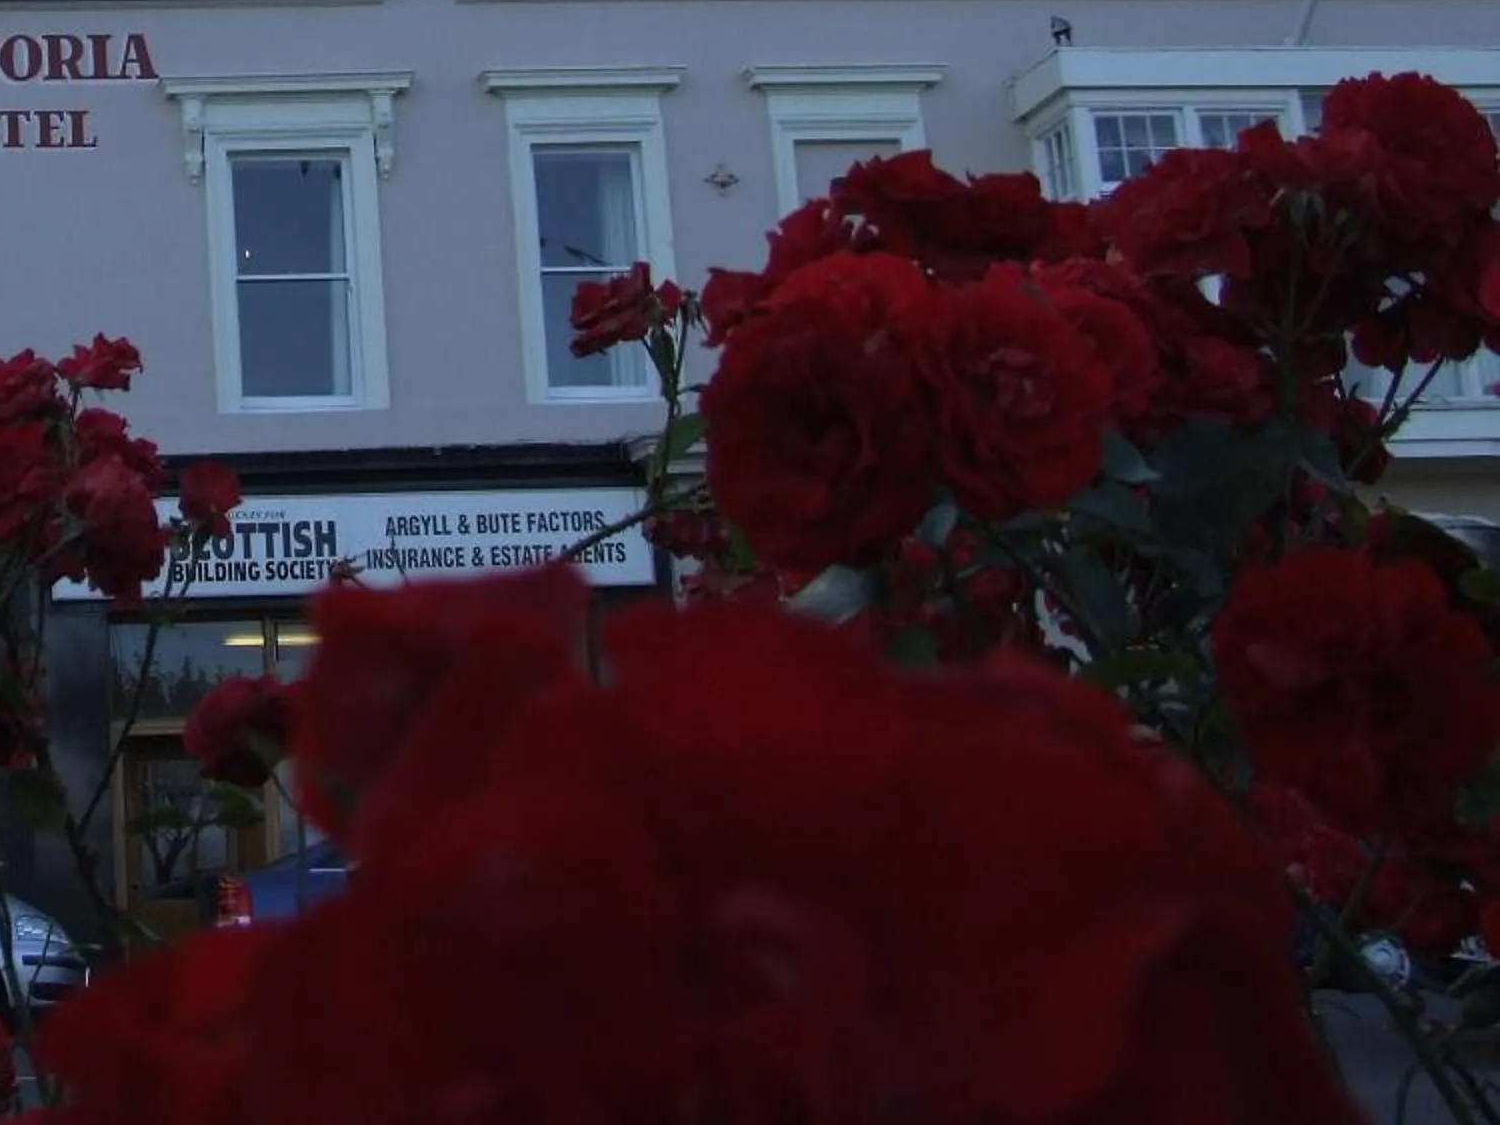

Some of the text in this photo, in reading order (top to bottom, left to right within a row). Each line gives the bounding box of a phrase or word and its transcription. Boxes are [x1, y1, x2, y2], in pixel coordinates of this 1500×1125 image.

[385, 510, 605, 537] ARGYLL & BUTE FACTORS
[366, 546, 465, 570] INSURANCE
[472, 545, 487, 567] &
[491, 543, 553, 566] ESTATE
[173, 558, 336, 583] BUILDING SOCIETY
